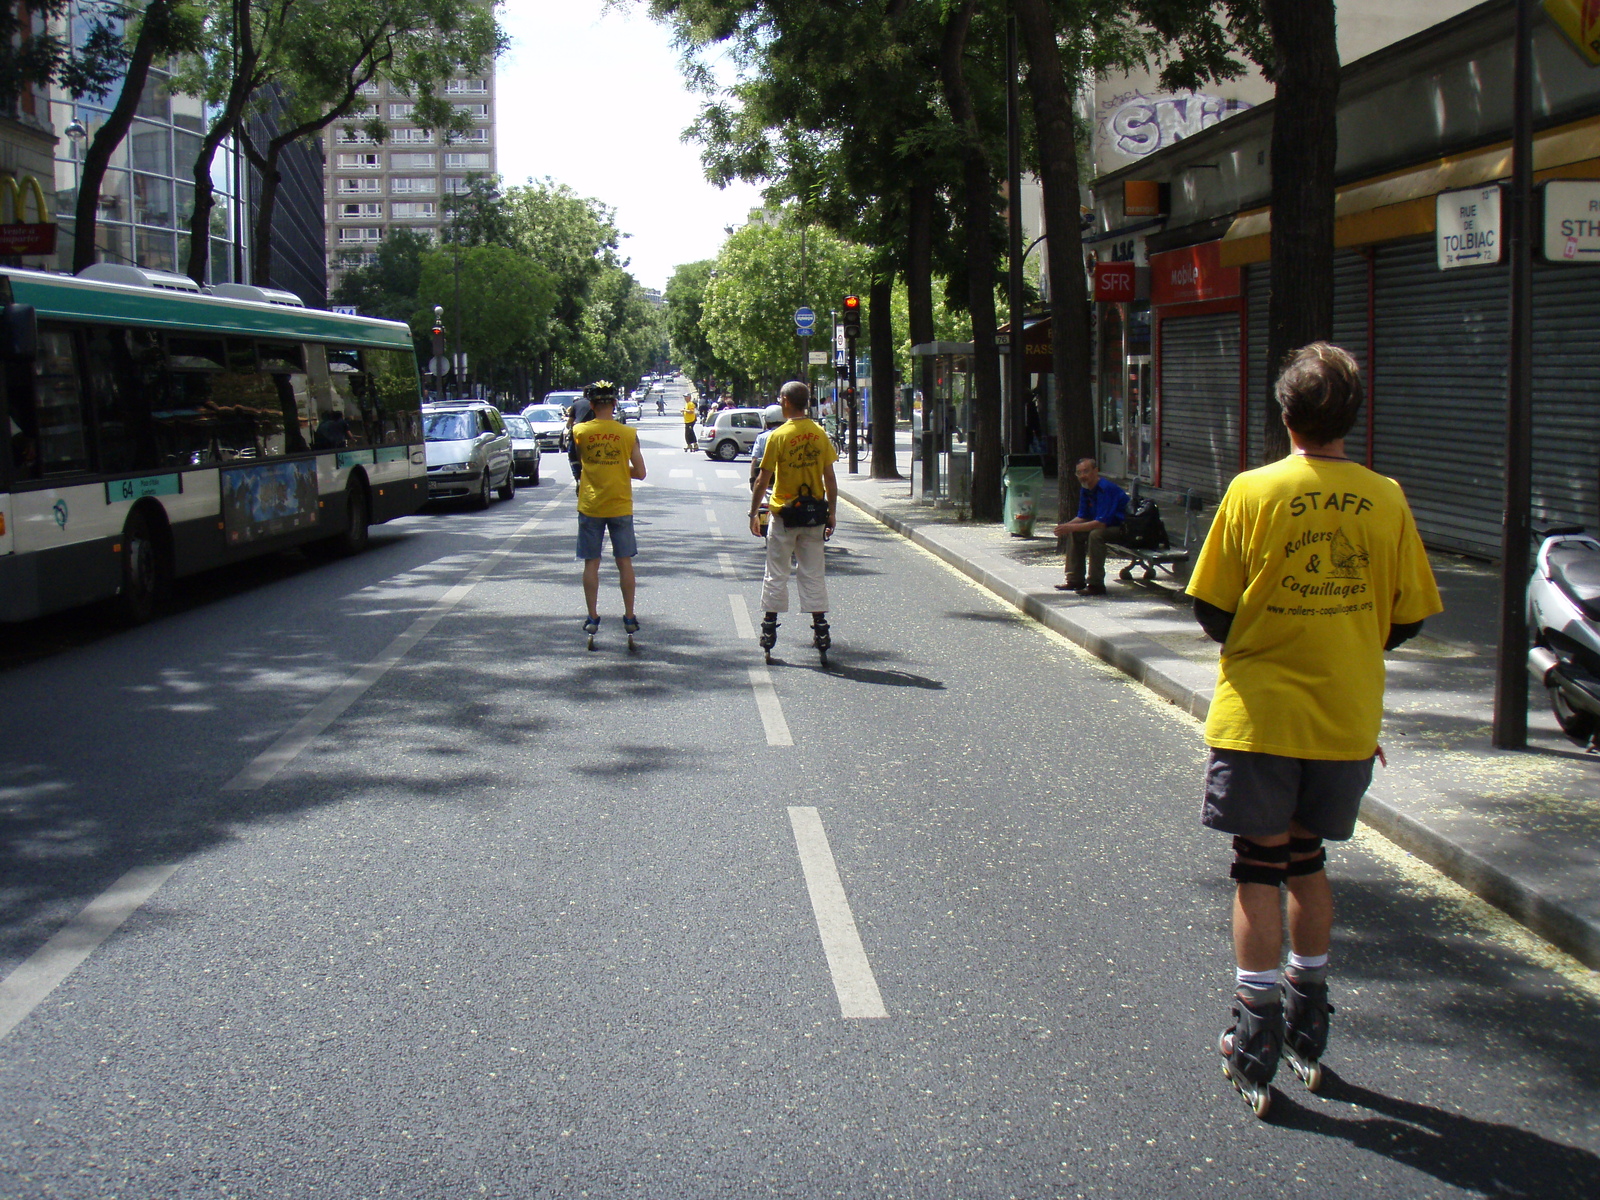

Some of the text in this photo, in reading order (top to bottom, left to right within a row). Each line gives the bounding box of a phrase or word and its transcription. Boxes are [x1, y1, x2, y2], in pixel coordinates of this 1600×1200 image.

[1460, 205, 1477, 218] RUE
[1463, 220, 1474, 230] DE
[1443, 230, 1494, 252] TOLBIAC
[1483, 250, 1492, 261] 72
[1101, 274, 1130, 290] SFR
[997, 336, 1008, 344] 76
[588, 433, 620, 443] STAFF
[790, 432, 820, 447] STAFF
[797, 453, 803, 461] &
[122, 480, 134, 499] 64
[1289, 491, 1374, 517] STAFF
[1284, 530, 1333, 558] Rollers
[1305, 554, 1321, 574] &
[1281, 575, 1367, 598] Coquillages
[1266, 601, 1373, 617] www.rollers-coquillages.org
